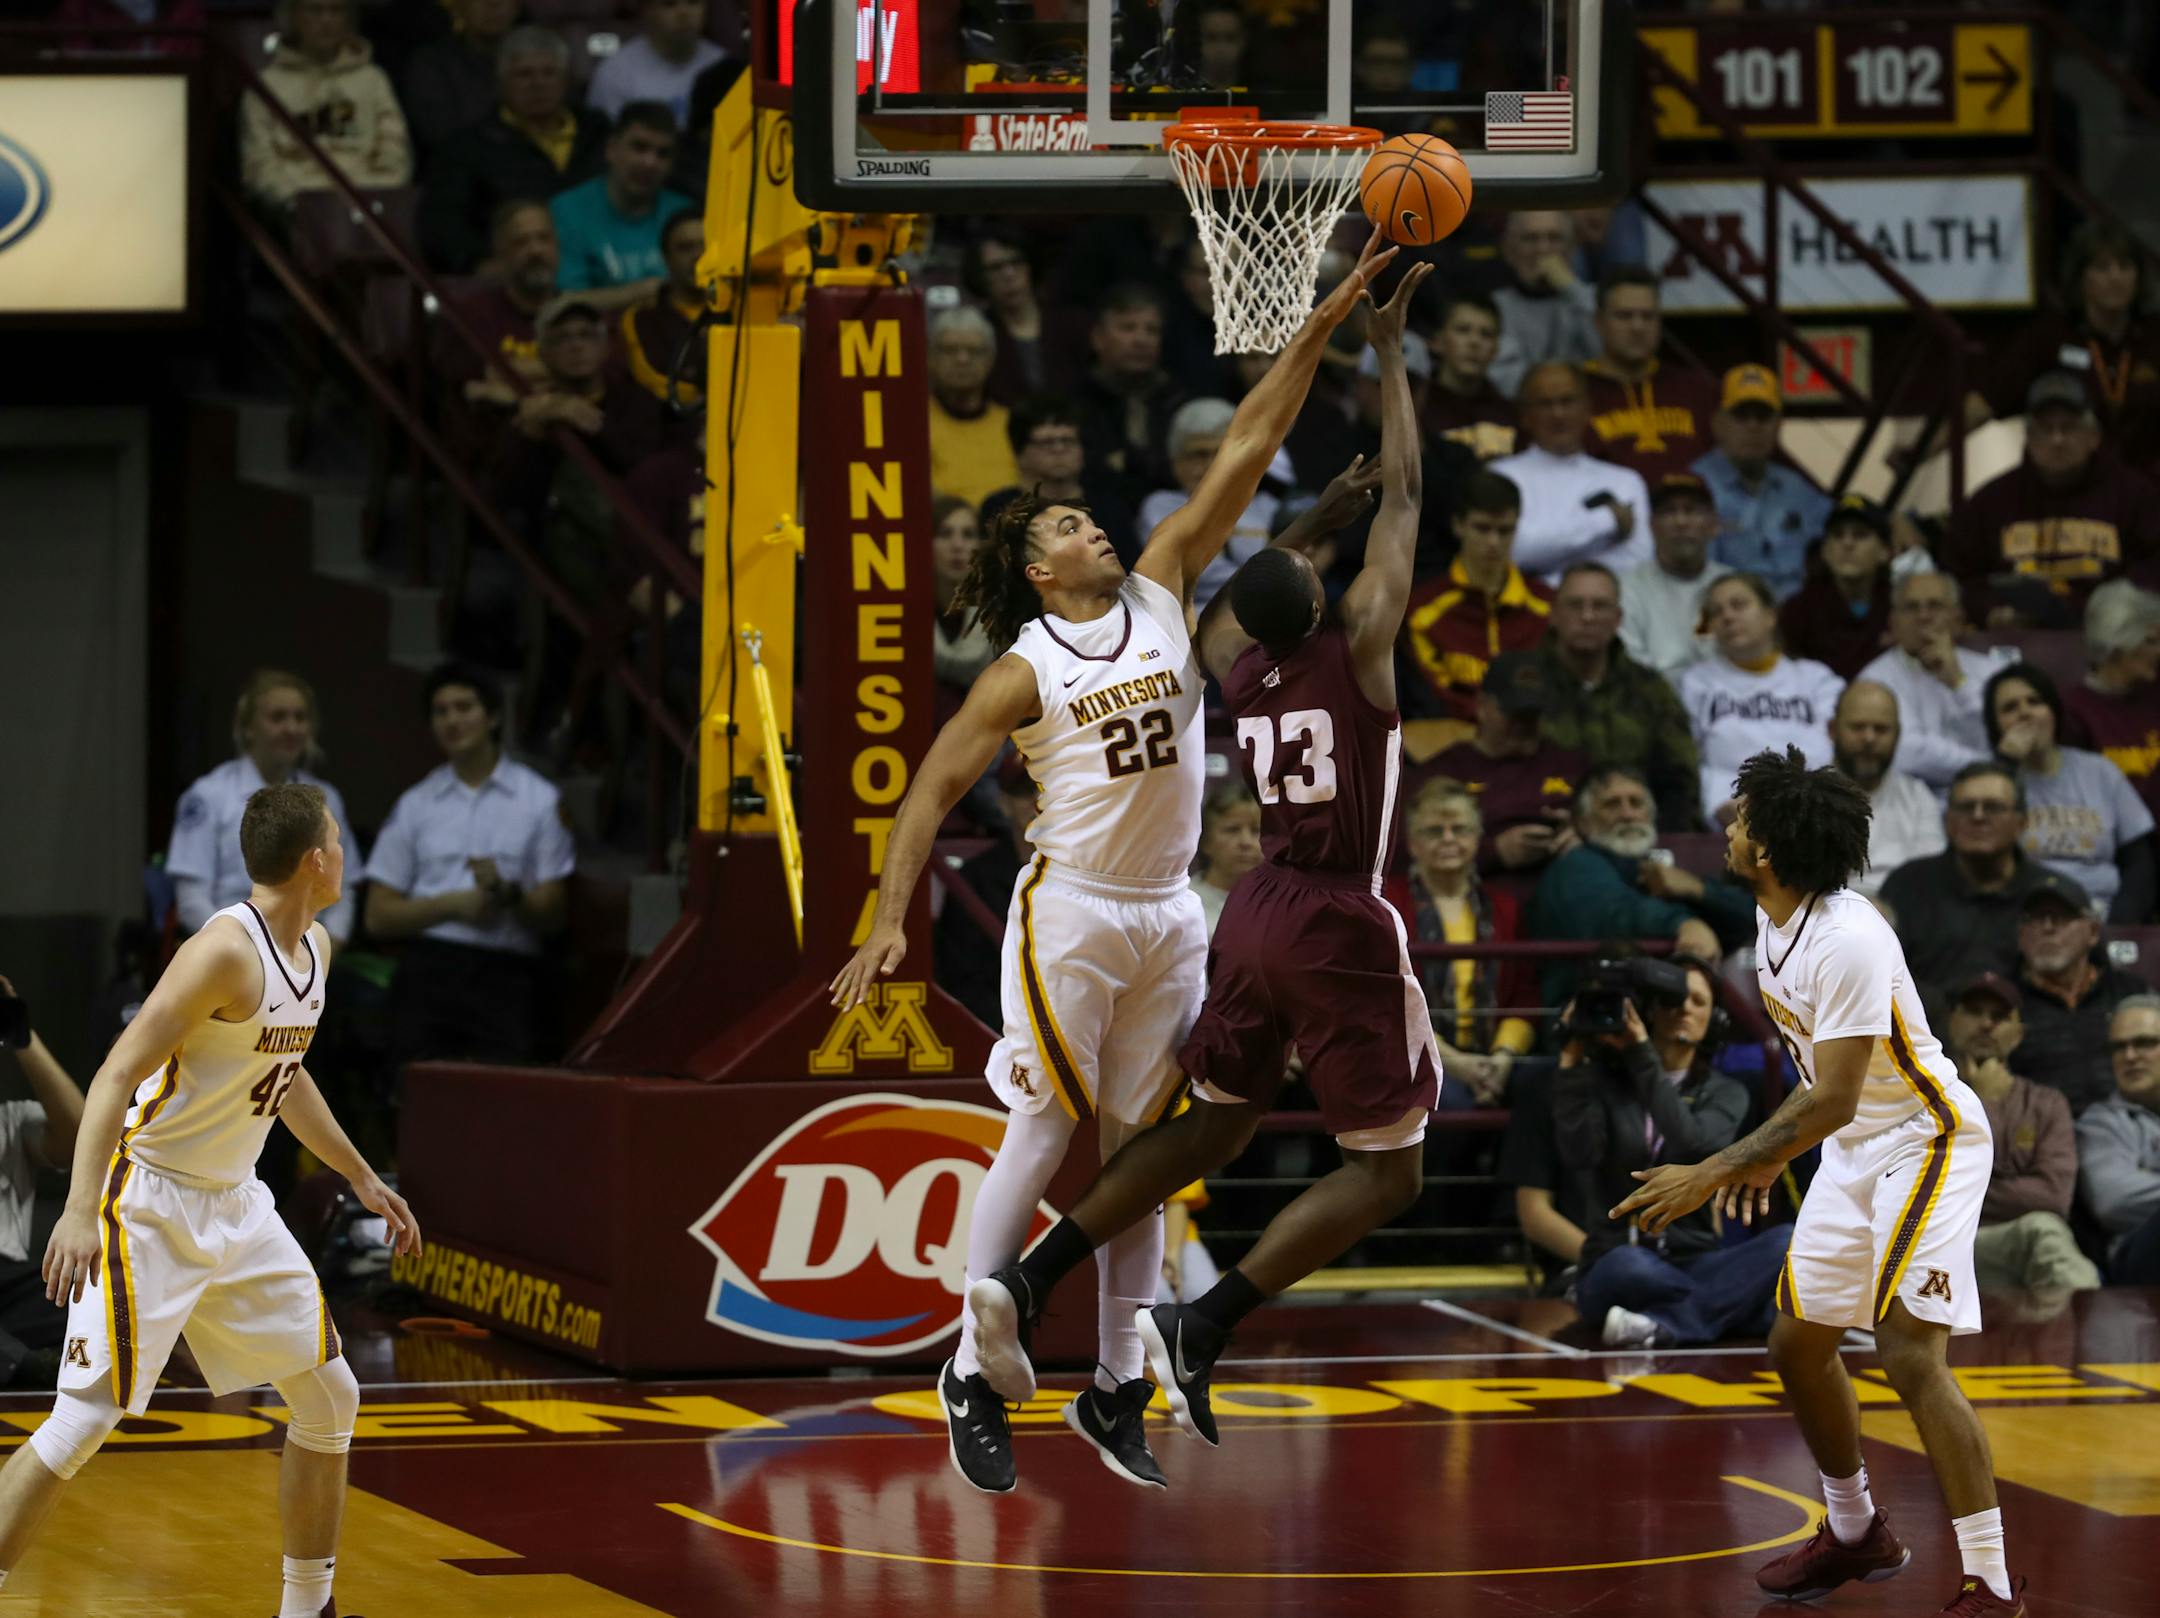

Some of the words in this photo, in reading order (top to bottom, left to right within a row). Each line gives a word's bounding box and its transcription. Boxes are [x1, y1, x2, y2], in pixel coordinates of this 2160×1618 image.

[1716, 47, 1802, 109] 101
[1847, 46, 1943, 107] 102
[857, 160, 930, 176] SPALDING
[1790, 216, 2000, 264] HEALTH
[1067, 669, 1183, 728] MINNESOTA
[1100, 708, 1179, 779] 22
[248, 1062, 300, 1117] 42
[759, 1157, 984, 1296] DQ
[390, 1241, 602, 1350] GOPHERSPORTS.com
